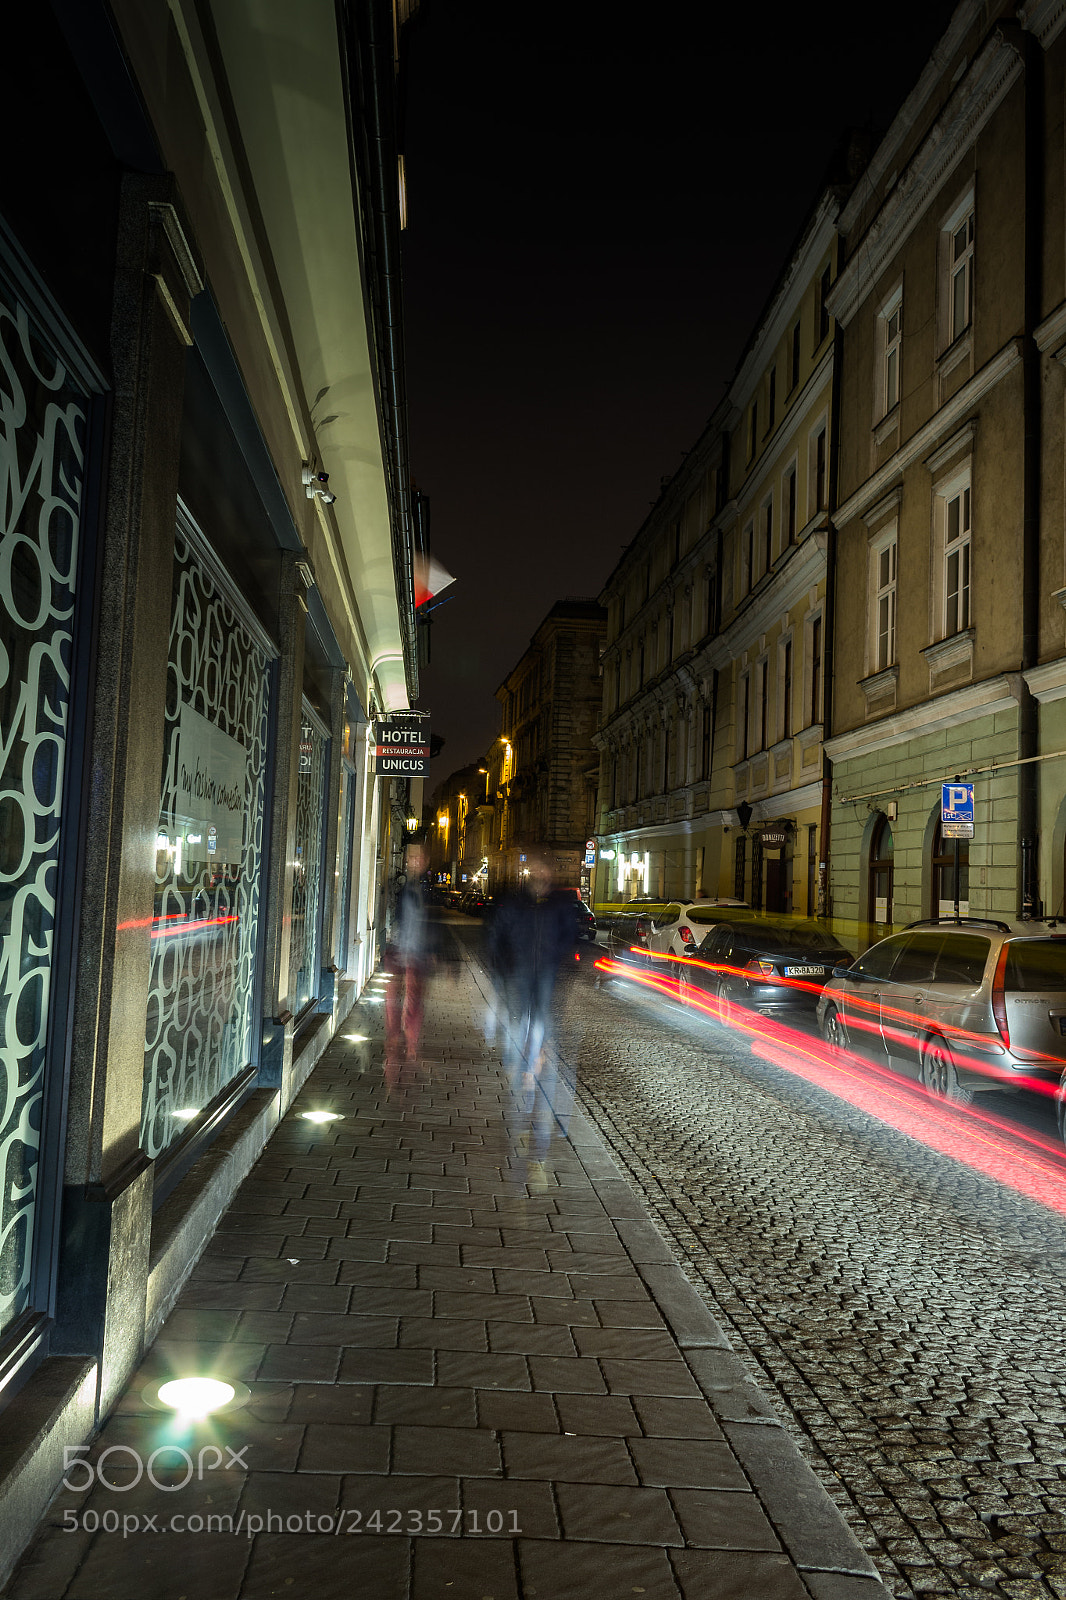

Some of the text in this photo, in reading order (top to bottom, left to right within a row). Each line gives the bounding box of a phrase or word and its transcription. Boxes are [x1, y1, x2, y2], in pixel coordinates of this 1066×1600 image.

[382, 731, 426, 743] HOTEL
[382, 759, 424, 771] UNICUS
[949, 787, 967, 811] P
